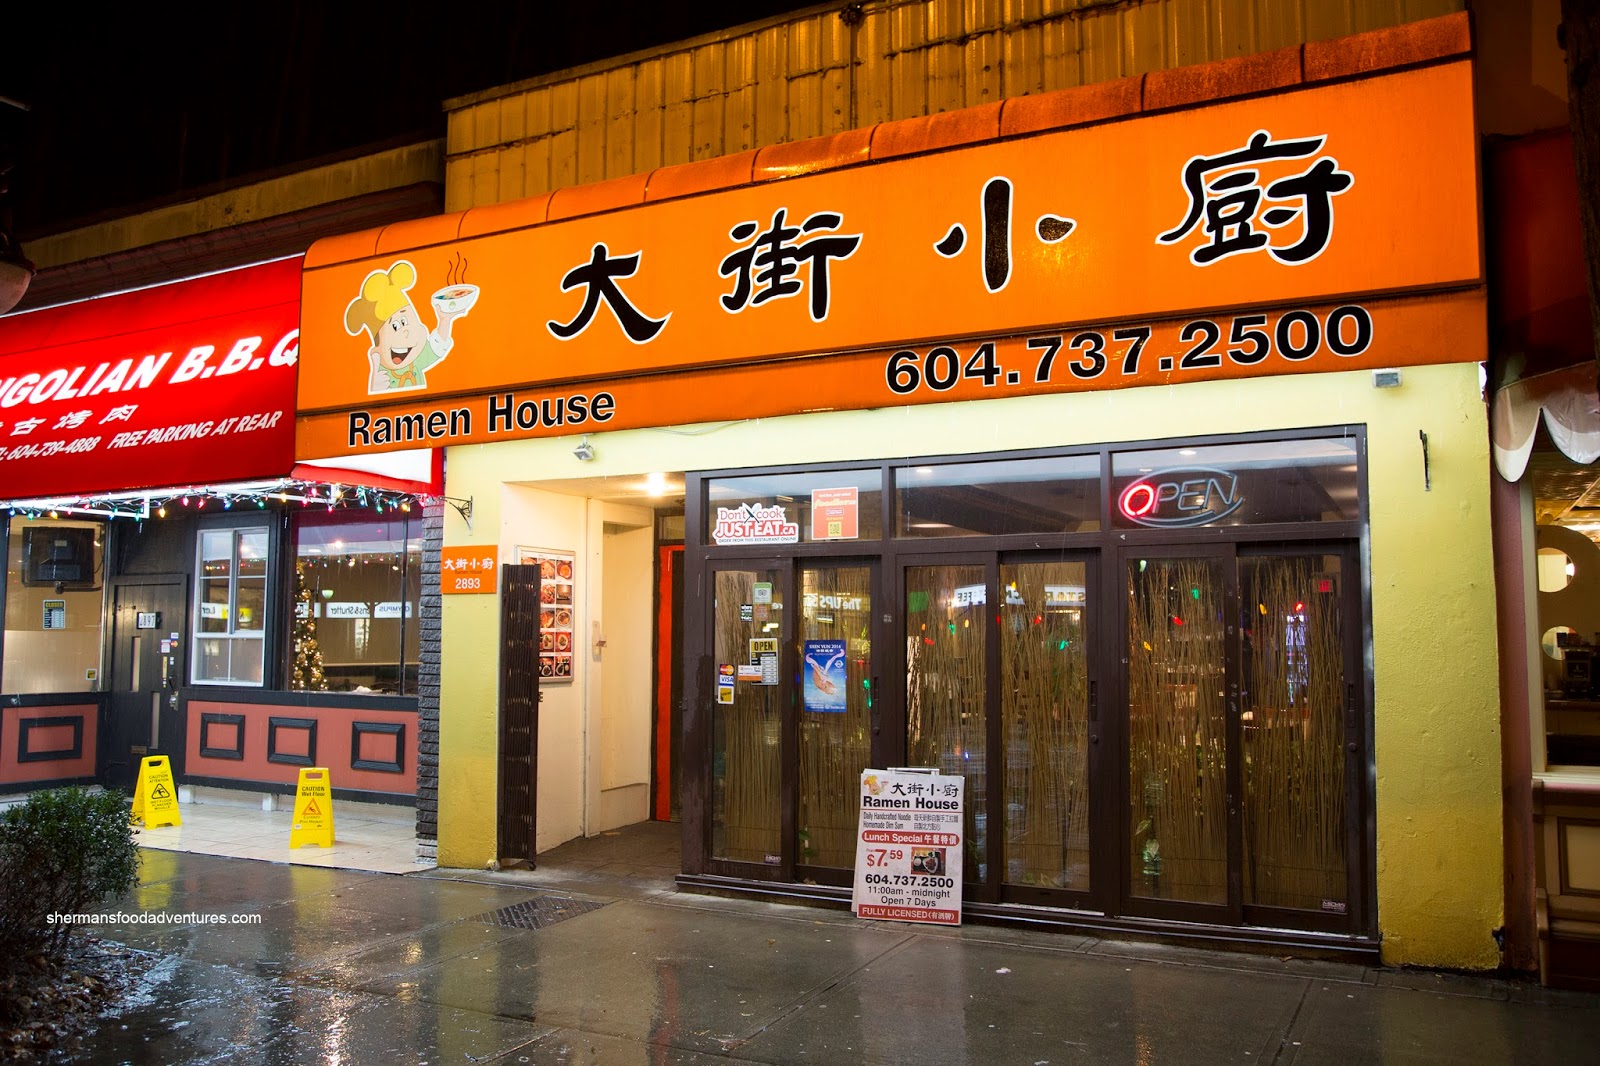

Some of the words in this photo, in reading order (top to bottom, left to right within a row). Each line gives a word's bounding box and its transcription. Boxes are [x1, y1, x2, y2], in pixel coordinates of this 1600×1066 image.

[168, 328, 299, 384] B.B.Q
[886, 304, 1373, 395] 604.737.2500
[0, 404, 138, 436] 古烤肉
[348, 406, 472, 449] Ramen
[487, 391, 616, 434] House
[107, 430, 148, 449] FREE
[142, 420, 214, 445] PARKING
[210, 417, 239, 436] AT
[233, 411, 282, 433] REAR
[1123, 478, 1238, 516] OPEN
[756, 508, 783, 518] cook
[455, 577, 481, 589] 2893
[754, 641, 773, 651] OPEN
[863, 796, 910, 809] Ramen
[915, 797, 959, 810] House
[864, 832, 890, 842] Lunch
[892, 833, 923, 844] Special
[865, 874, 954, 888] 604.737.2500
[868, 886, 903, 894] 11:00am
[911, 889, 950, 899] midnight
[881, 895, 904, 905] Open
[914, 898, 936, 908] Days
[862, 907, 886, 915] FULLY
[887, 909, 928, 918] LICENSED
